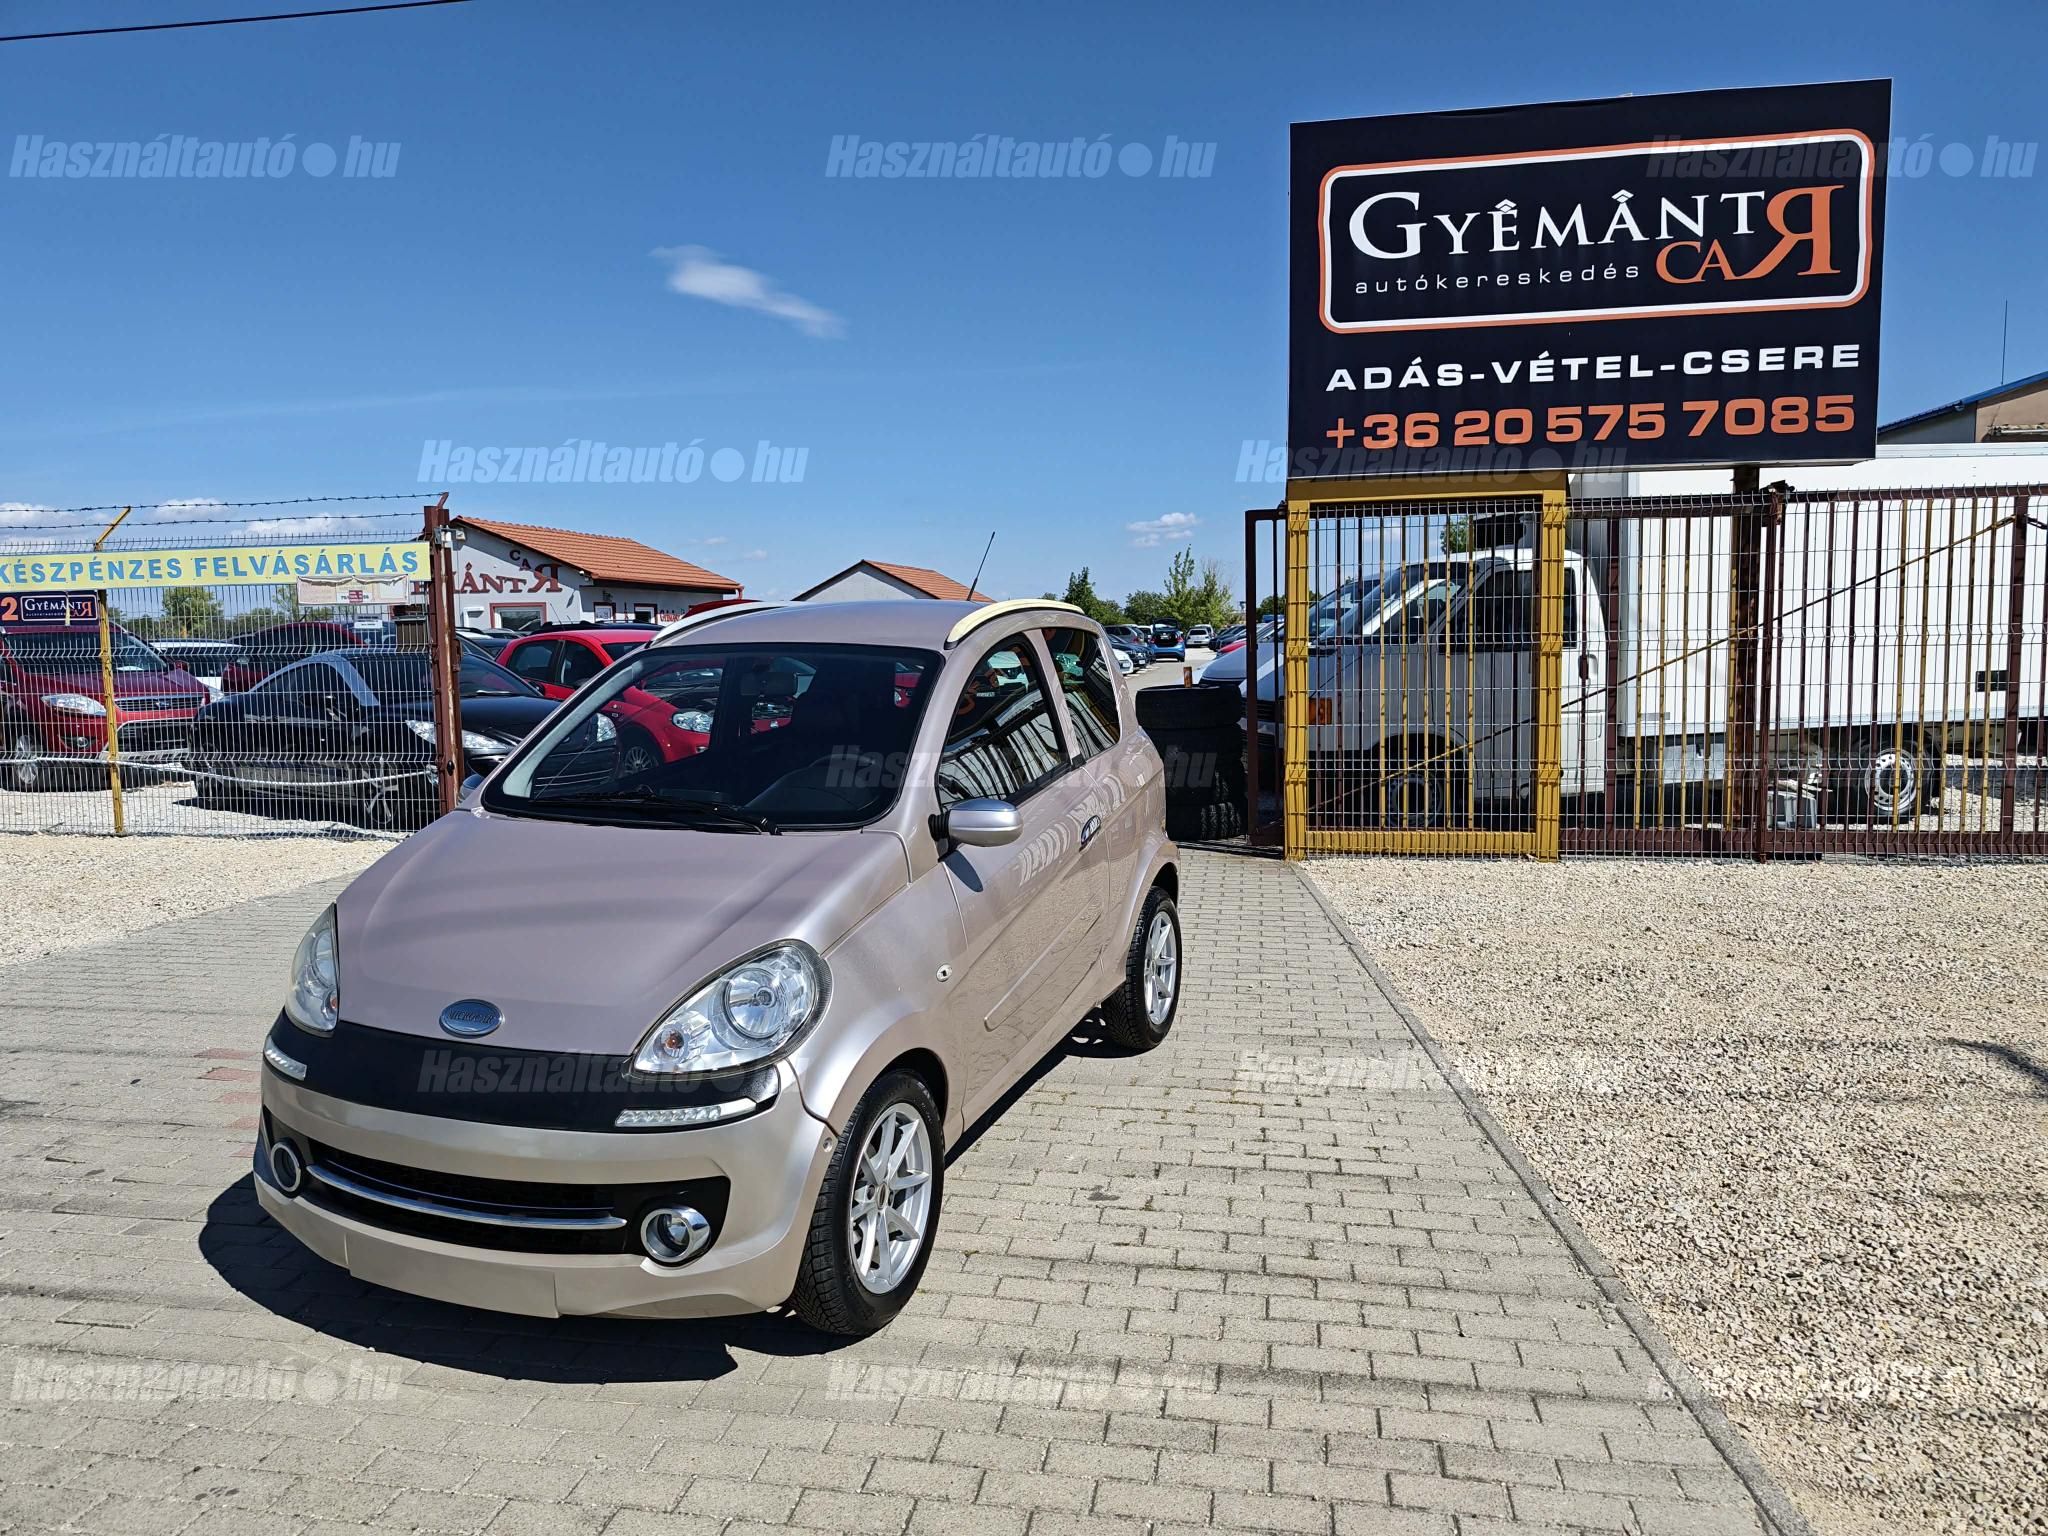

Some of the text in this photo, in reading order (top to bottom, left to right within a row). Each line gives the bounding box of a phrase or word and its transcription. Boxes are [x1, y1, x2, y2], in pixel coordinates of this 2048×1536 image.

[1355, 264, 1639, 294] autókereskedés
[1325, 344, 1860, 392] ADÁS-VÉTEL-CSERE
[1326, 395, 1855, 449] +36 20 575 7085
[194, 547, 418, 577] FELVÁSÁRLÁS
